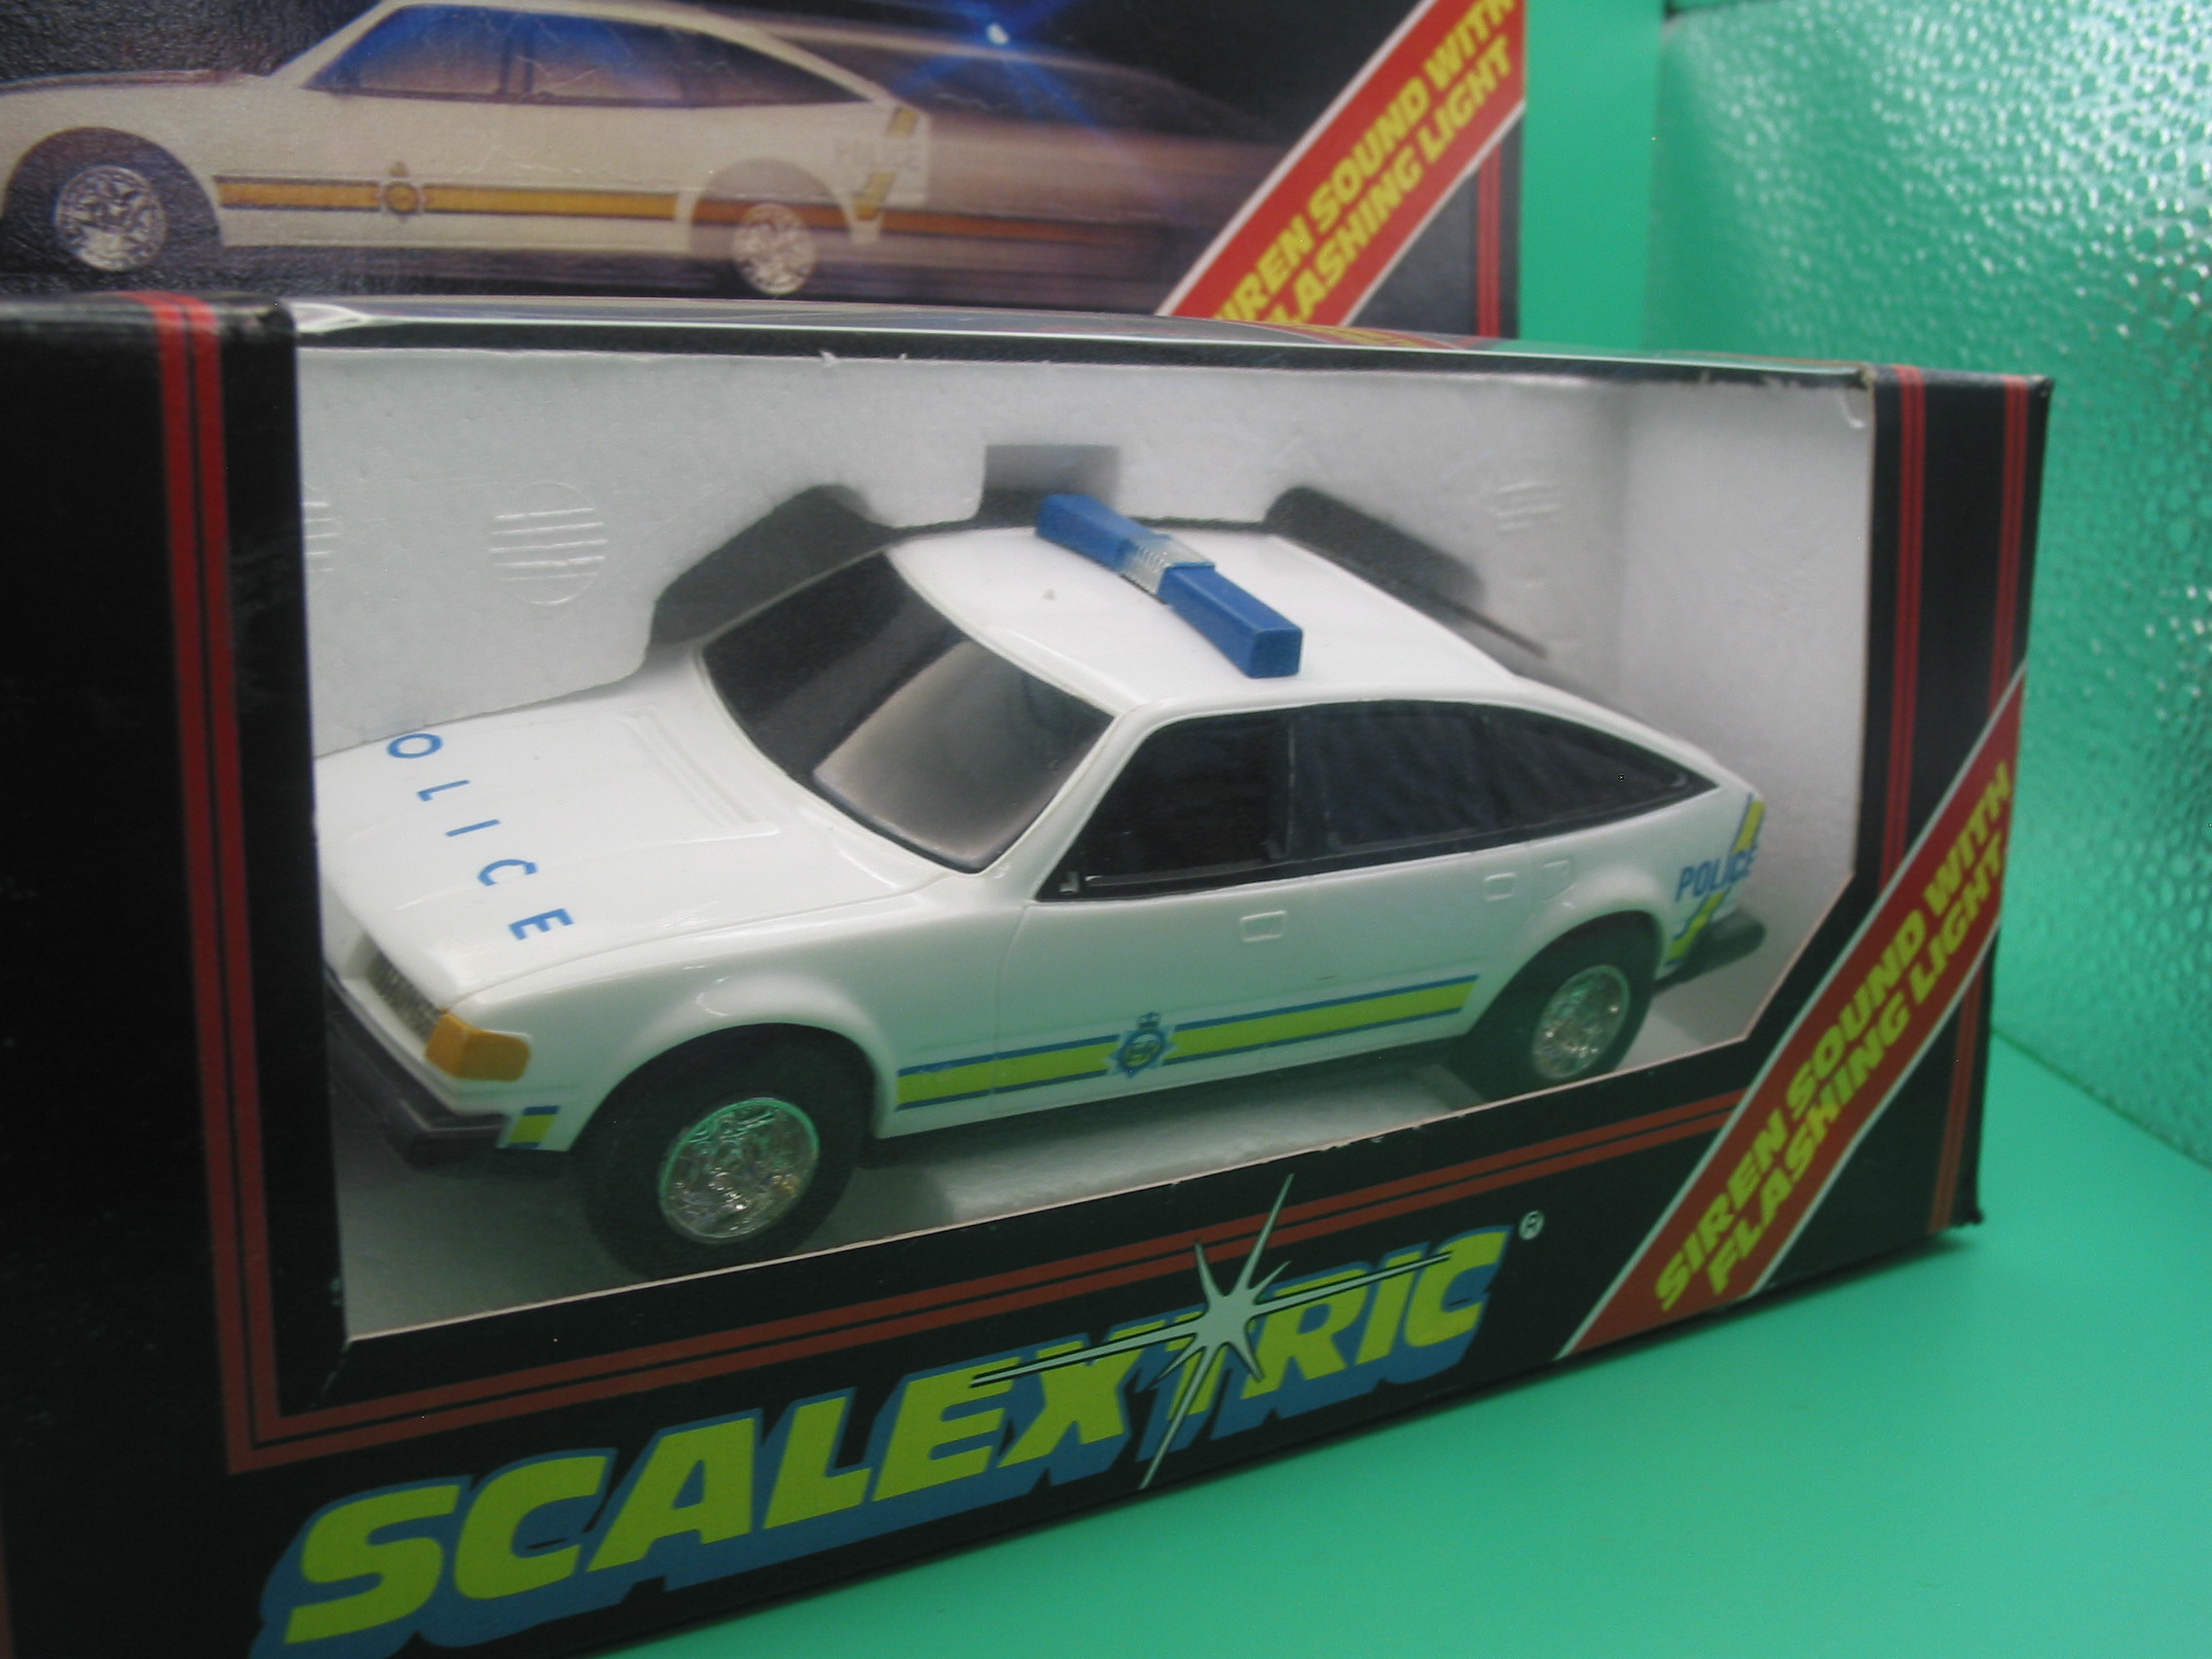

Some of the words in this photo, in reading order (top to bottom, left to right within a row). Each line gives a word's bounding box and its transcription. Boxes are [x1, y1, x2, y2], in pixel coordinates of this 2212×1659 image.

[1308, 76, 1430, 233] SOUND
[1418, 34, 1511, 164] LIGHT
[386, 732, 574, 940] OLICE
[1655, 1110, 1788, 1311] SIREN
[1786, 909, 1927, 1106] SOUND
[1922, 759, 2011, 917] WITH
[1708, 993, 1910, 1296] FLASHING
[1914, 829, 2004, 1007] LIGHT
[277, 1229, 1510, 1647] SCALEXTRIC
